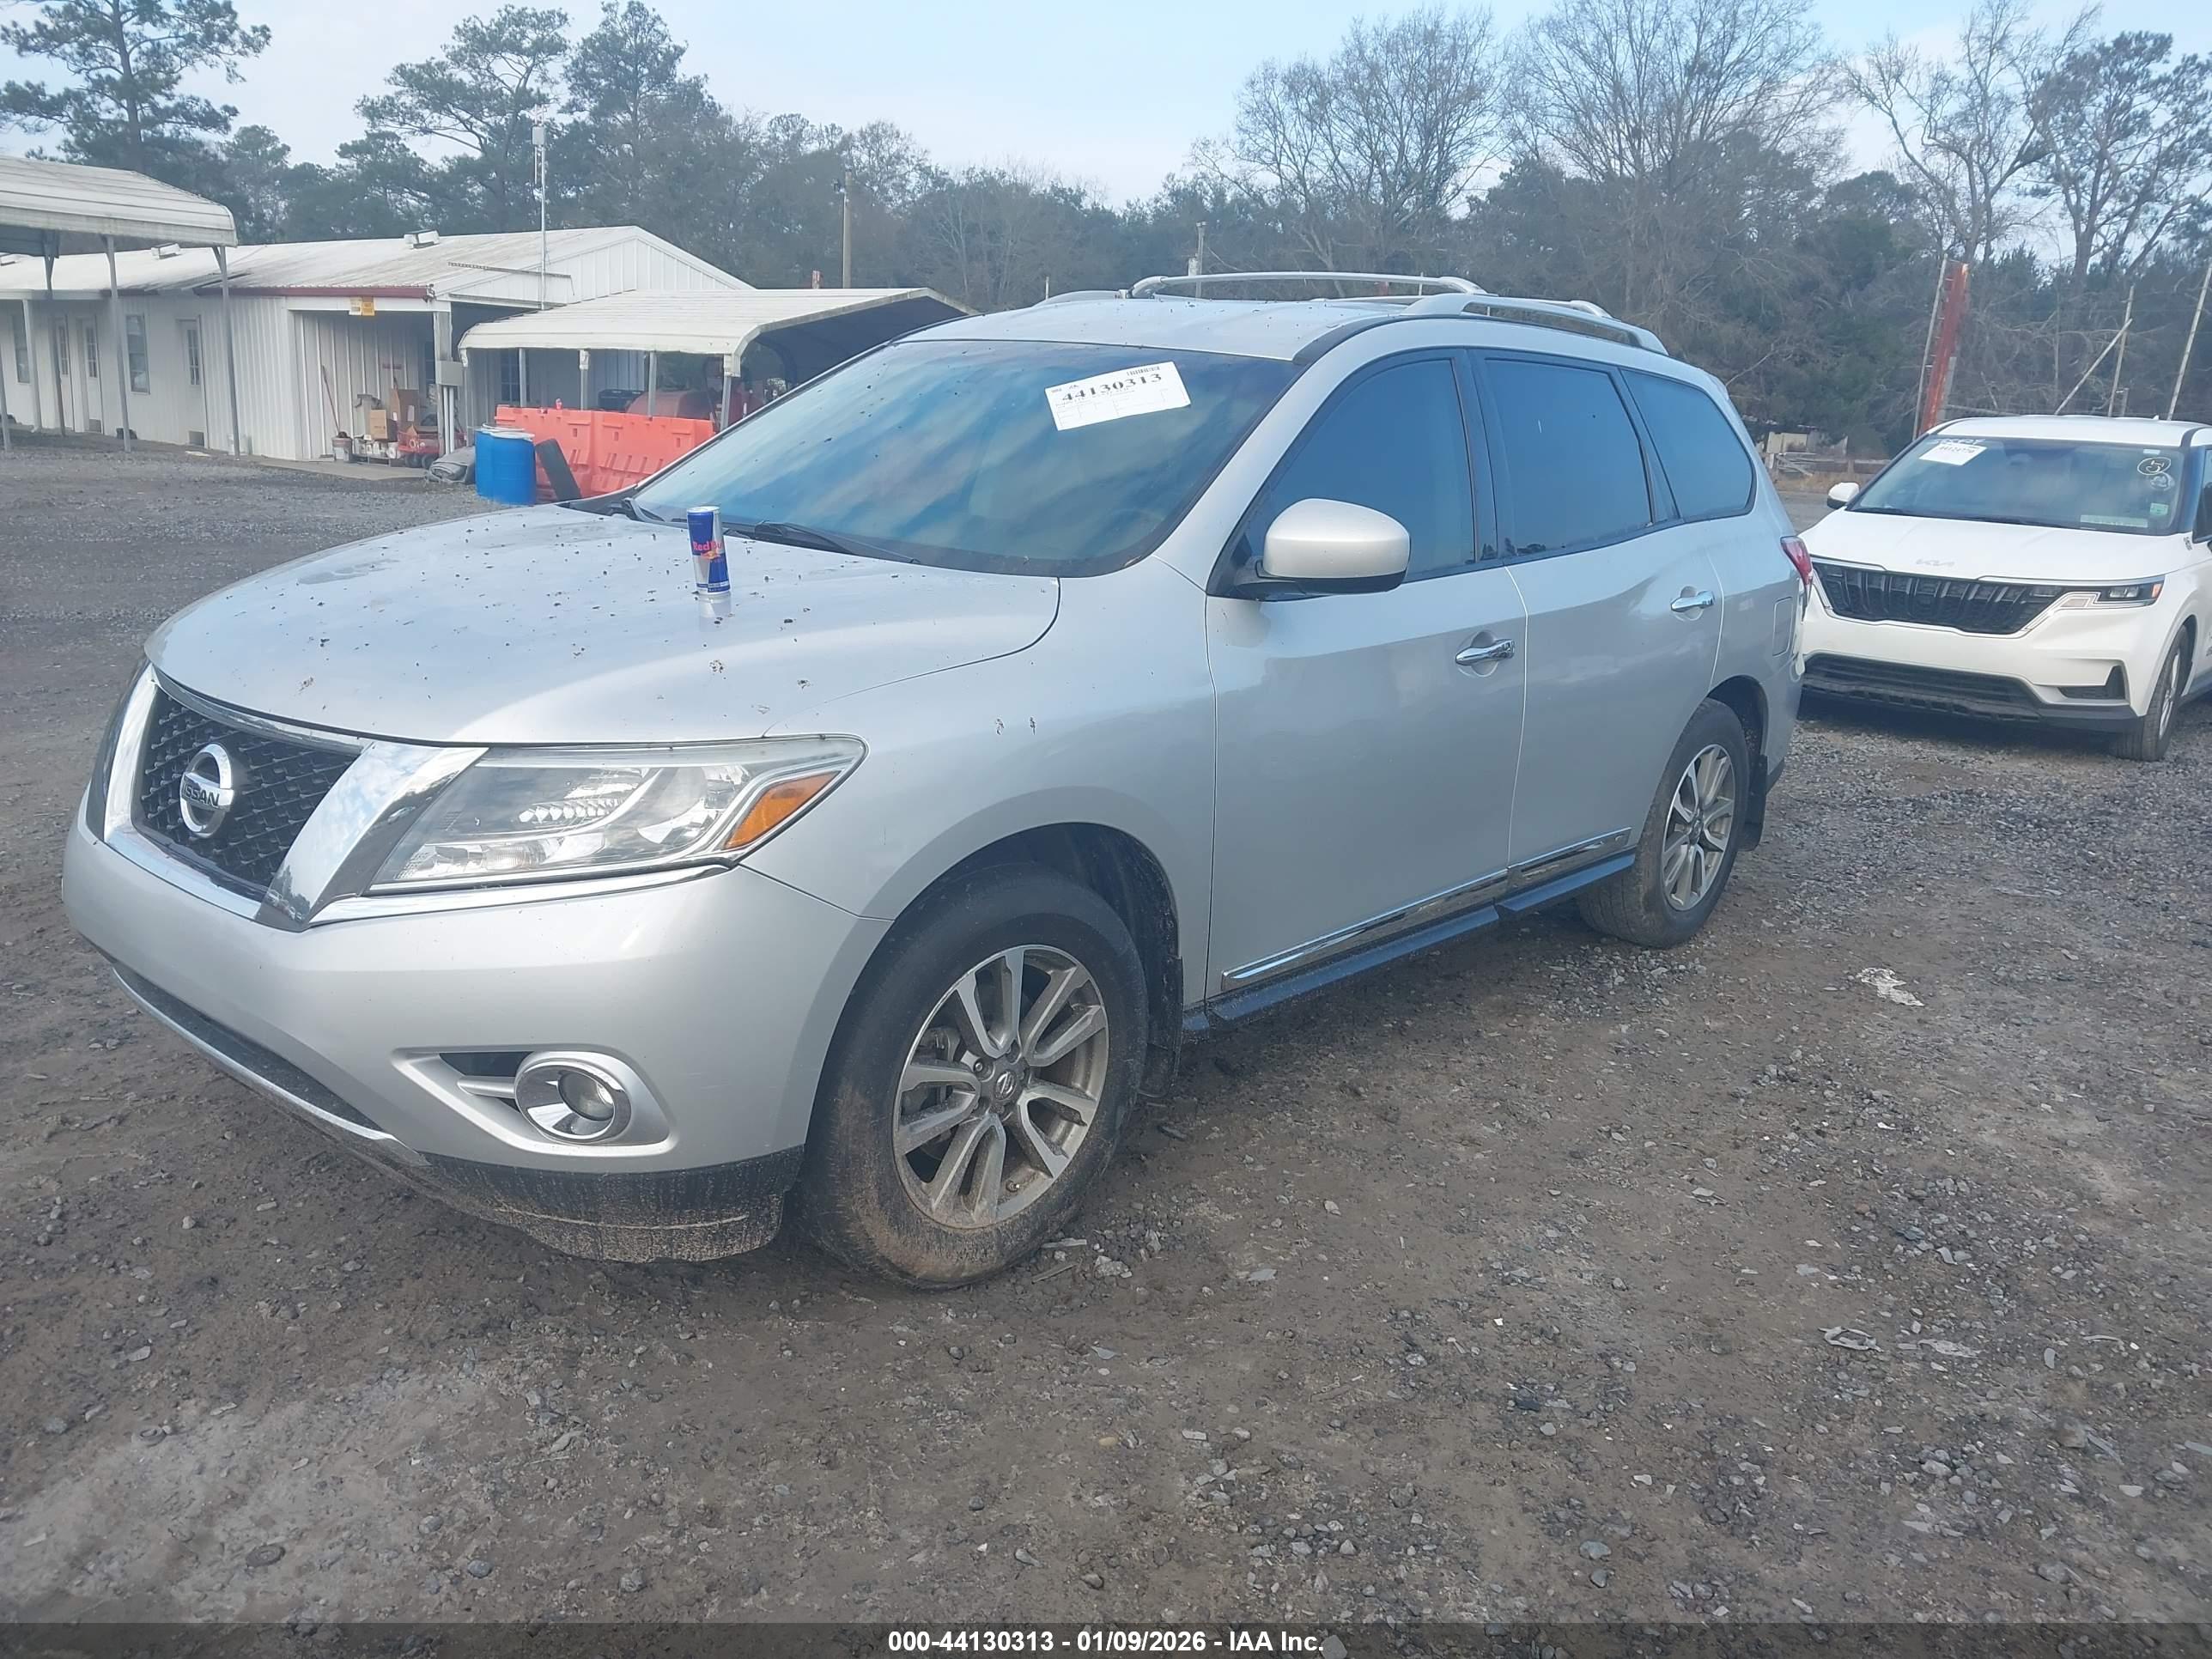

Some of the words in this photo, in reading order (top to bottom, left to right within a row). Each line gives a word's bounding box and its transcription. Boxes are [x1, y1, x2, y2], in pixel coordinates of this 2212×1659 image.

[1062, 374, 1162, 401] 44130313
[692, 540, 710, 550] Red
[710, 541, 723, 550] Bu
